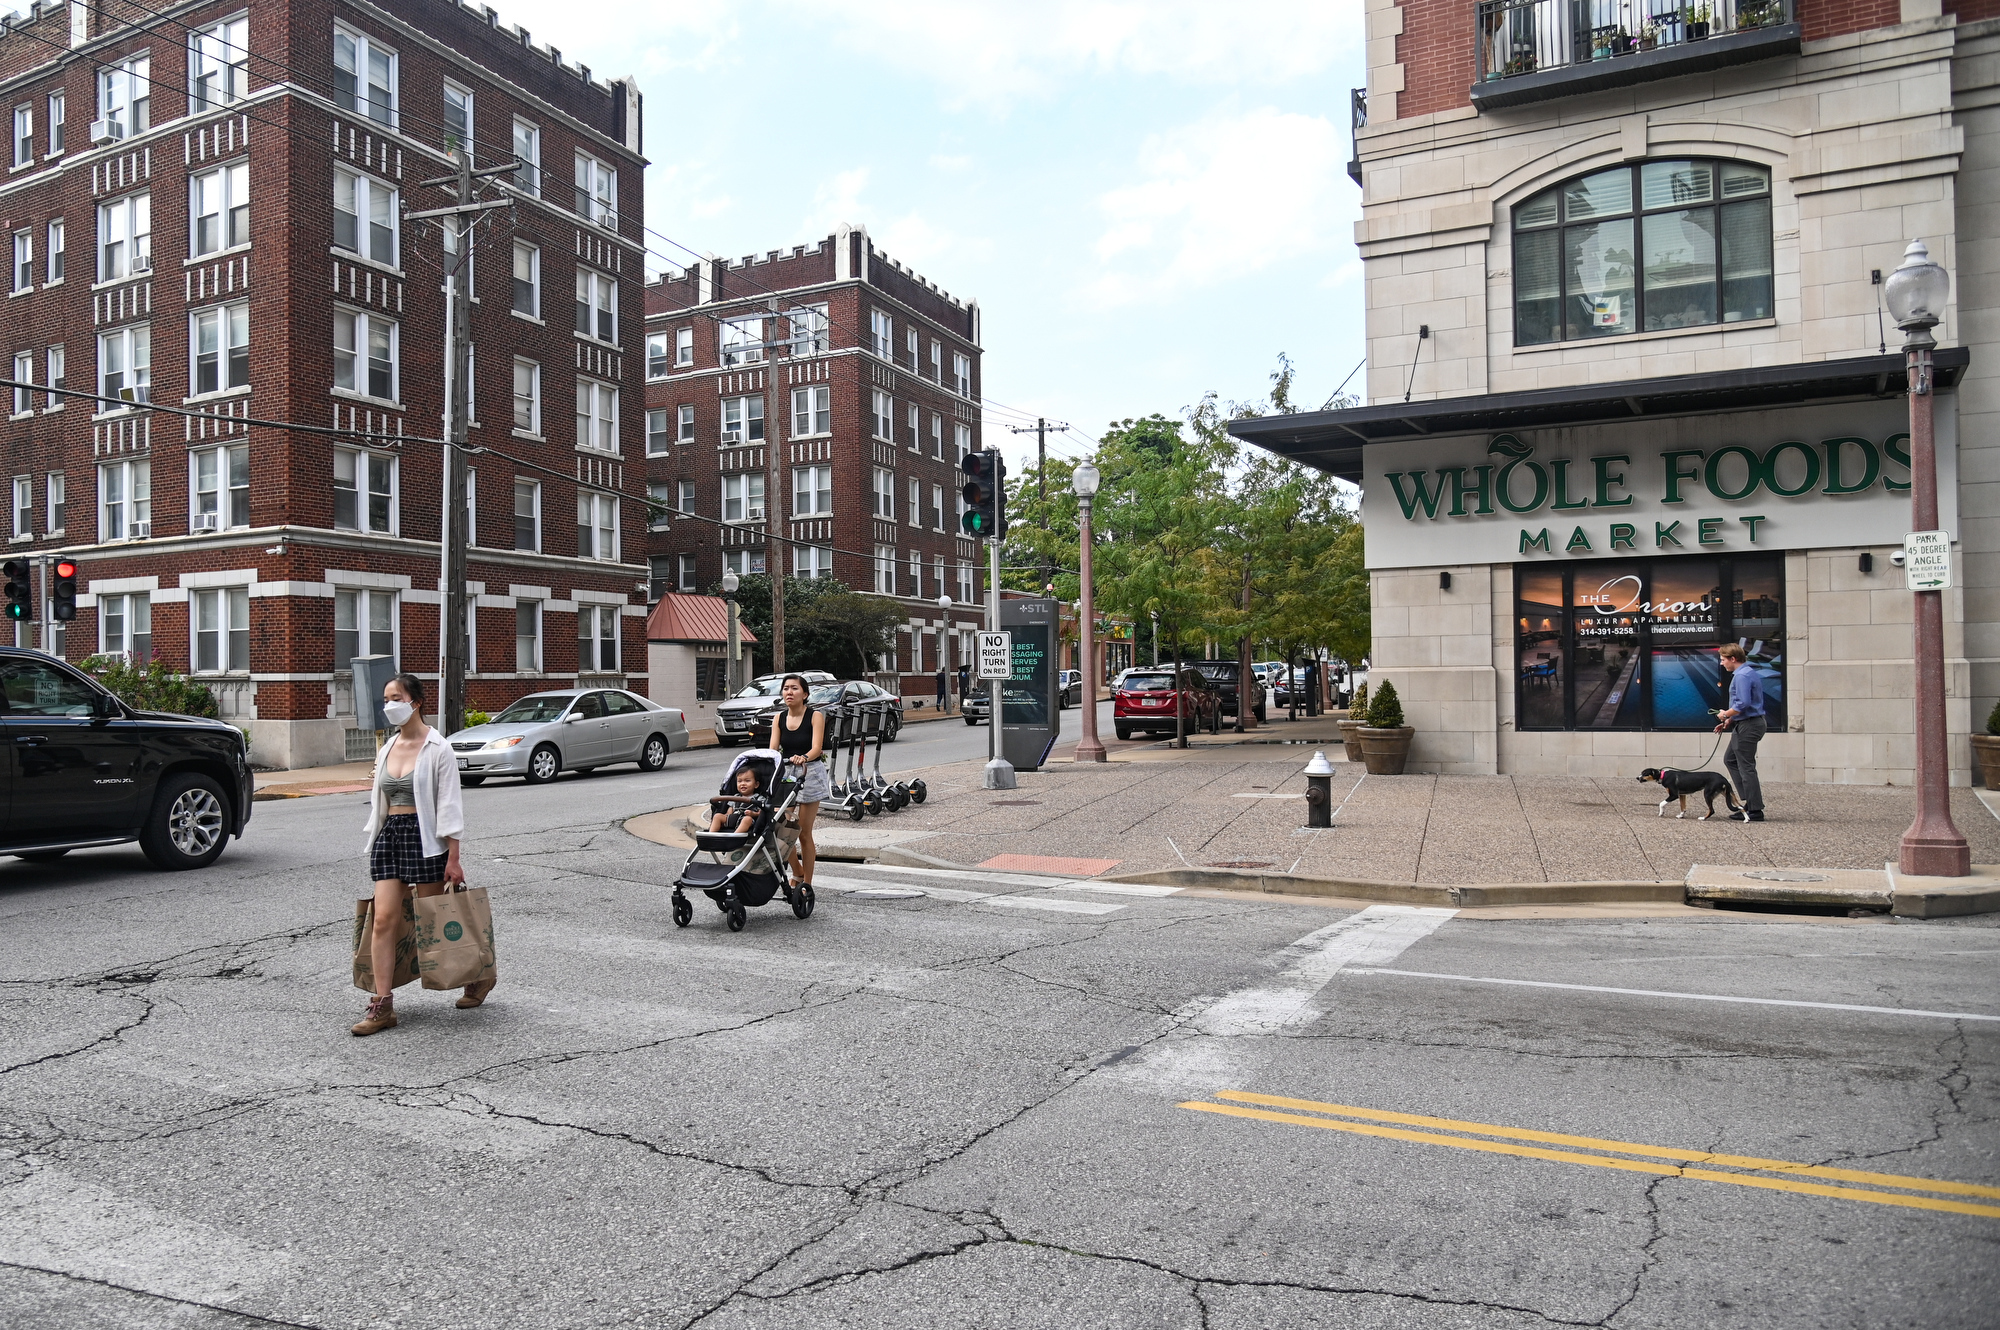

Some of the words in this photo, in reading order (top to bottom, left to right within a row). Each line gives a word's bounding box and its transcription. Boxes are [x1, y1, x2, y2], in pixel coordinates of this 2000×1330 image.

[1384, 448, 1633, 520] WHOLE
[1659, 433, 1911, 503] FOODS
[1518, 515, 1766, 553] MARKET
[1916, 535, 1937, 543] PARK
[1908, 547, 1917, 555] 45
[1921, 545, 1947, 554] DEGREE
[1915, 556, 1942, 565] ANGLE
[1580, 594, 1610, 603] THE
[1593, 575, 1712, 615] Orion
[1028, 604, 1048, 613] STL
[1581, 617, 1625, 626] LUXURY
[1632, 615, 1713, 624] APARTMENTS
[1580, 627, 1634, 636] 314-391-5258
[1651, 625, 1714, 634] theorioncwe.com
[986, 636, 1003, 647] NO
[40, 682, 54, 690] NO
[1002, 688, 1014, 697] ke
